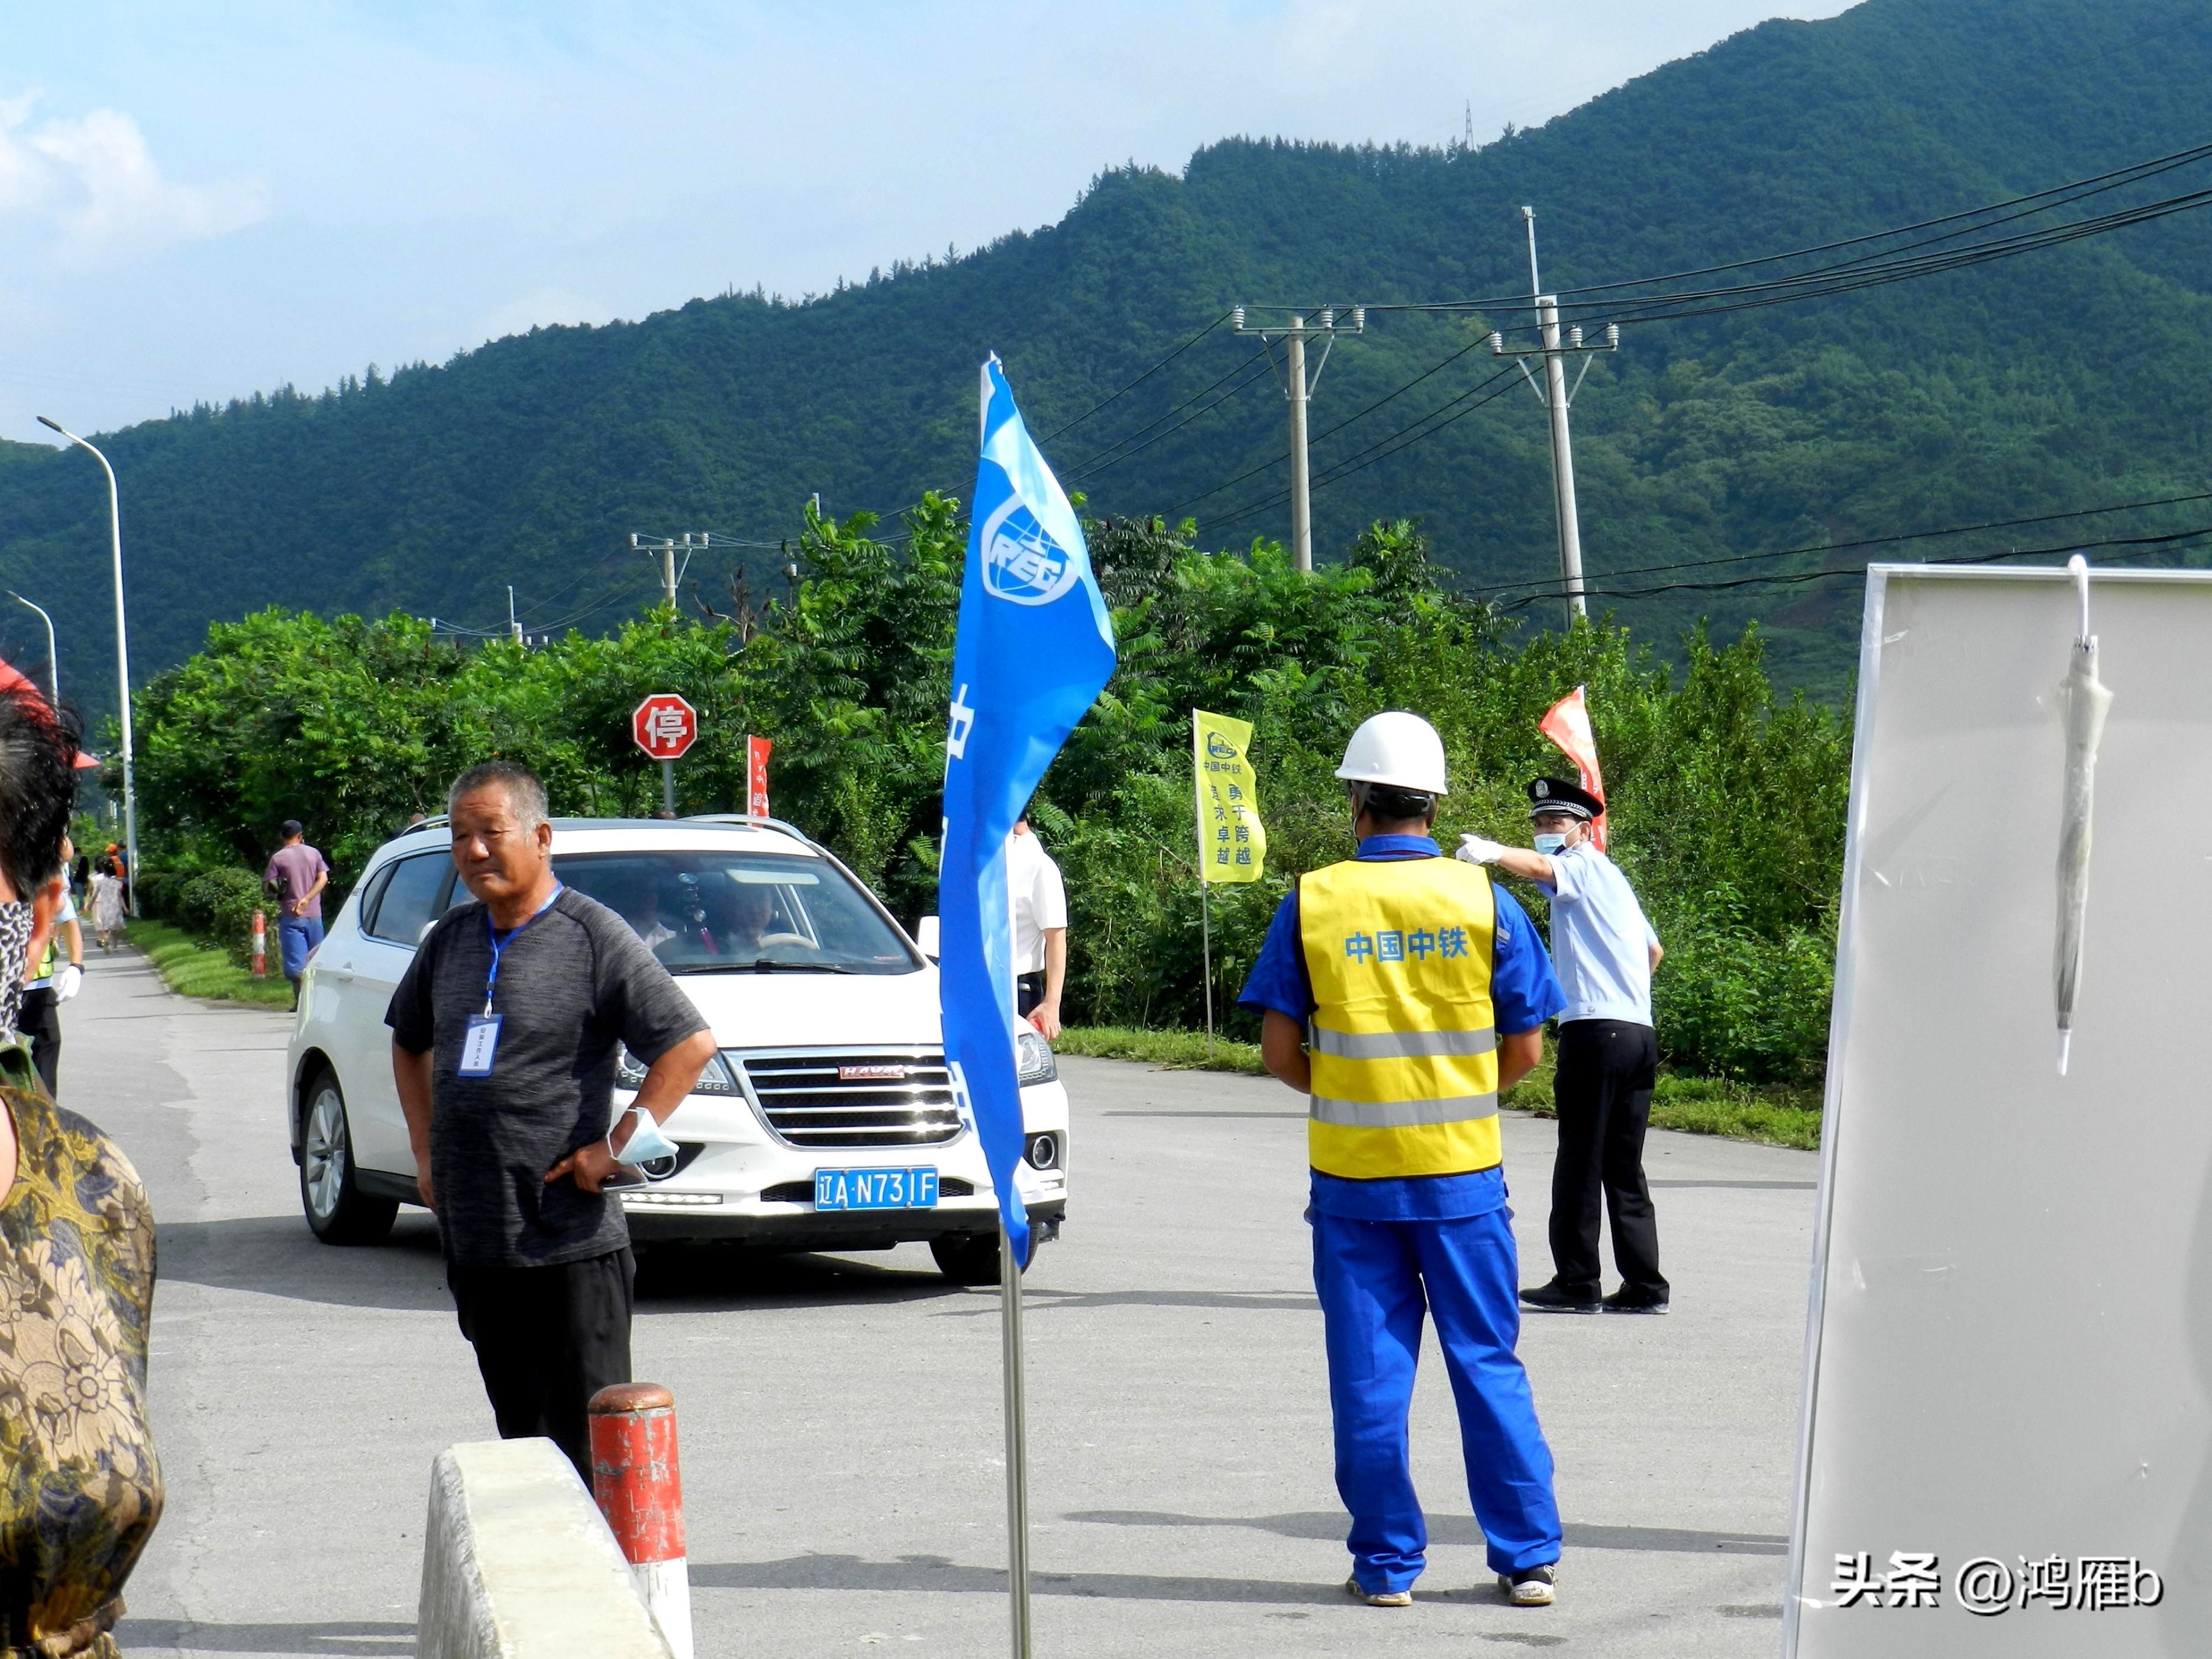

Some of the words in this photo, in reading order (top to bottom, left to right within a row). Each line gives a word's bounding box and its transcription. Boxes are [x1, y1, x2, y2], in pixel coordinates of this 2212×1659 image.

[645, 706, 687, 748] 停
[1203, 761, 1242, 774] 中国中铁
[1229, 784, 1251, 864] 勇于跨越
[1345, 926, 1468, 964] 中国中铁
